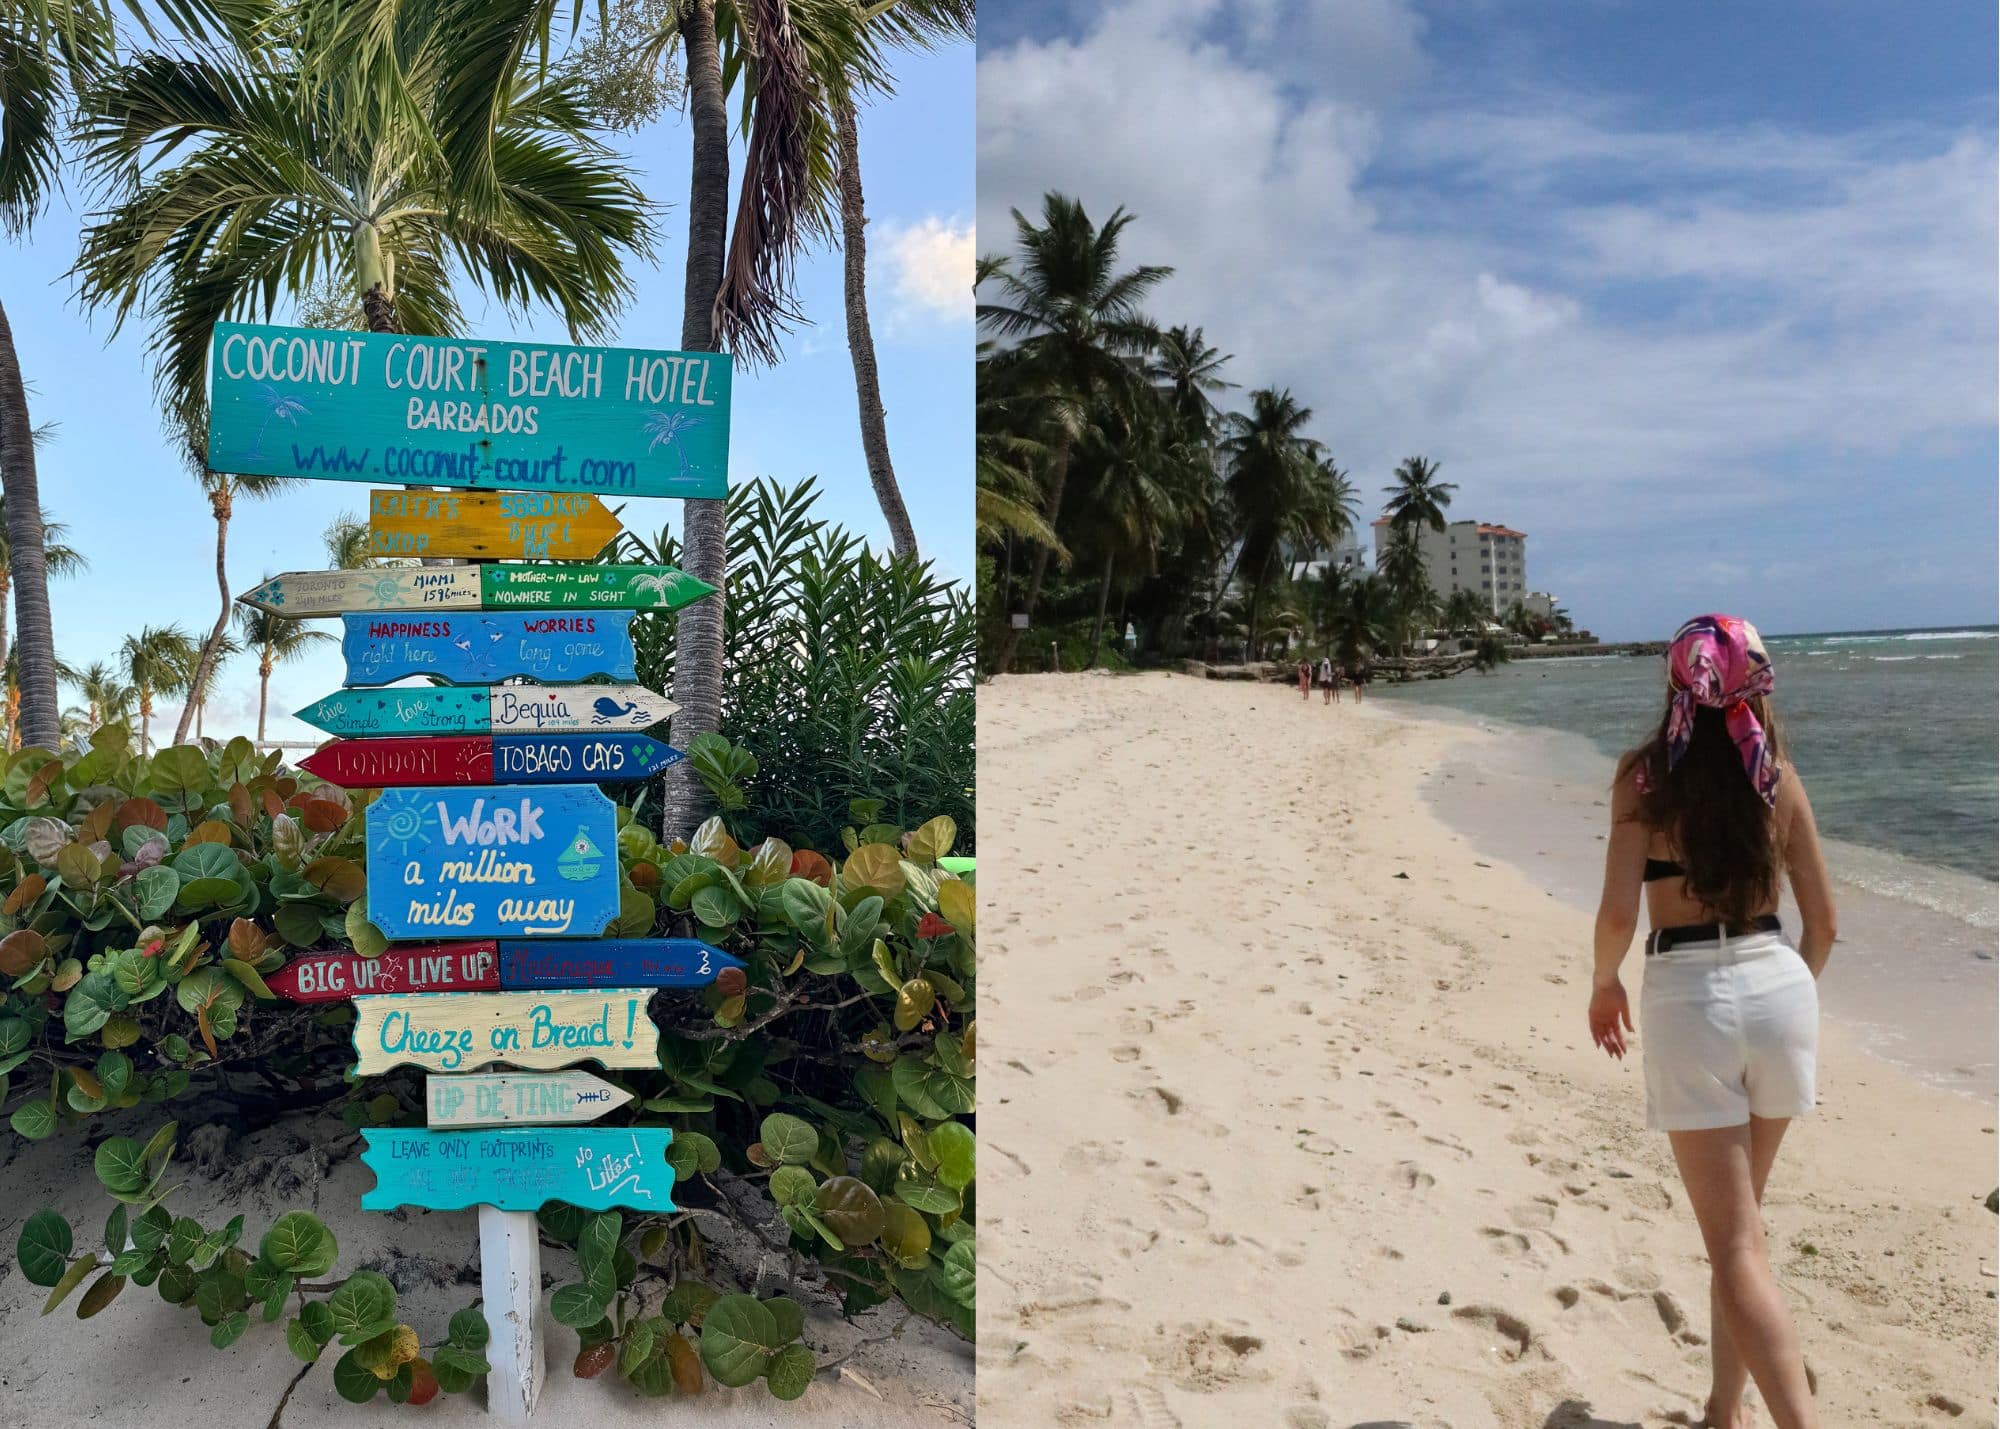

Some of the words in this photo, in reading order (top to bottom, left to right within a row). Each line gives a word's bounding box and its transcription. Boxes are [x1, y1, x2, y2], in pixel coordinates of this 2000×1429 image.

[222, 333, 367, 386] COCONUT
[385, 342, 488, 393] COURT
[508, 348, 603, 398] BEACH
[625, 354, 715, 406] HOTEL
[407, 396, 539, 435] BARBADOS
[291, 442, 636, 489] www.coconut-court.com
[413, 573, 455, 589] MIAMI
[494, 590, 552, 604] NOWHERE
[562, 591, 578, 602] IN
[589, 590, 627, 603] SIGHT
[368, 620, 451, 639] HAPPINESS
[523, 618, 596, 634] WORRIES
[361, 642, 395, 676] right
[519, 639, 552, 671] long
[500, 692, 571, 728] Bequia
[337, 748, 437, 776] LONDON
[500, 743, 572, 774] TOBAGO
[582, 742, 625, 772] CAYS
[404, 860, 425, 885] a
[438, 848, 536, 885] million
[407, 888, 476, 926] miles
[497, 898, 575, 935] away
[298, 960, 345, 994] BIG
[352, 958, 381, 989] UP
[408, 955, 454, 986] LIVE
[461, 951, 493, 982] UP
[379, 1010, 474, 1070] Cheeze
[490, 1027, 519, 1051] on
[433, 1086, 465, 1120] UP
[475, 1084, 504, 1118] DE
[512, 1082, 575, 1117] TING
[392, 1140, 431, 1160] LEAVE
[438, 1138, 471, 1160] ONLY
[479, 1137, 555, 1161] FOOTPRINTS
